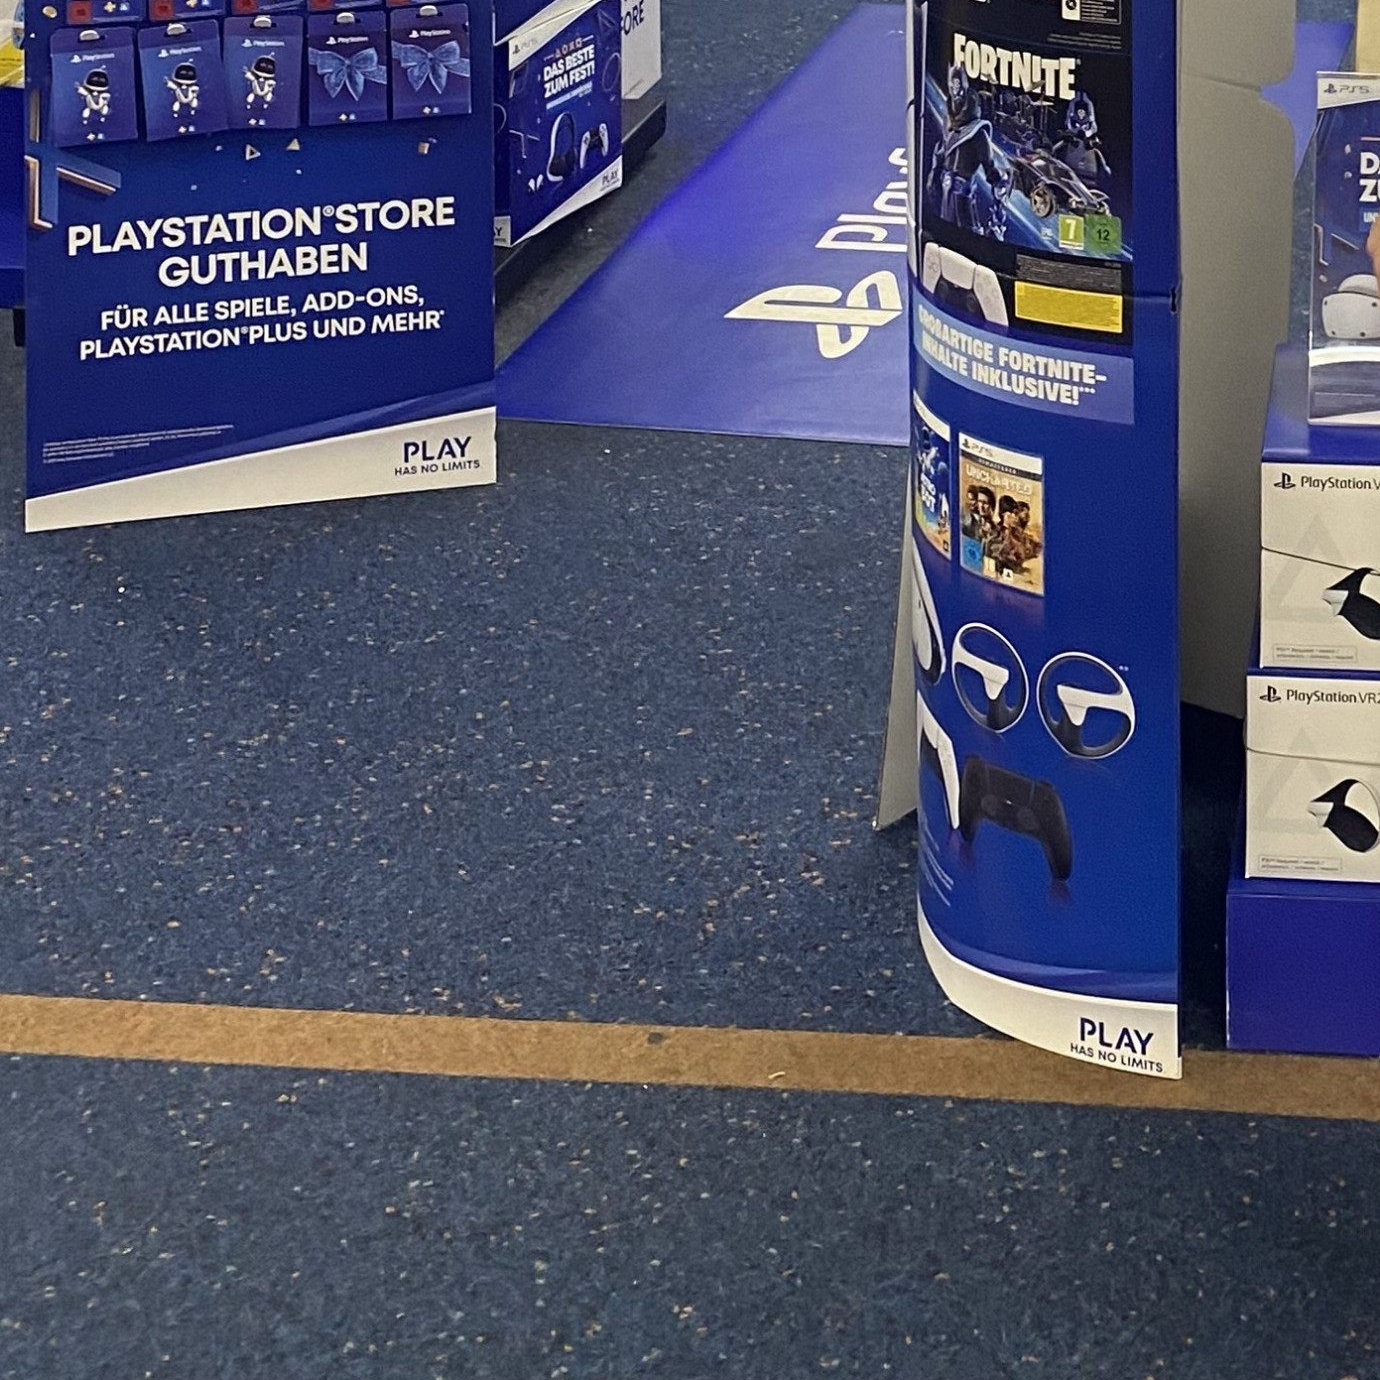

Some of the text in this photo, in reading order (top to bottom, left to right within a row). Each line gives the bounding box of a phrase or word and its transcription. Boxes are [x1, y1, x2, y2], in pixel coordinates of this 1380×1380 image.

[543, 43, 596, 83] DAS BESTE
[952, 32, 1077, 101] FORTNITE
[543, 75, 570, 99] ZUM
[335, 195, 456, 234] STORE
[1065, 218, 1077, 240] 7
[1096, 228, 1111, 241] 12
[157, 241, 369, 289] GUTHABEN
[100, 283, 426, 332] FÜR ALLE SPIELE, ADD-ONS,
[248, 319, 308, 346] PLUS
[312, 314, 367, 341] UND
[998, 346, 1108, 385] FORTNITE-
[402, 435, 472, 464] PLAY
[395, 458, 481, 476] HAS NO LIMITS
[1300, 476, 1373, 493] PlayStation
[1286, 688, 1358, 706] PlayStation
[1080, 1016, 1155, 1056] PLAY
[1069, 1042, 1164, 1073] HAS NO LIMITS
